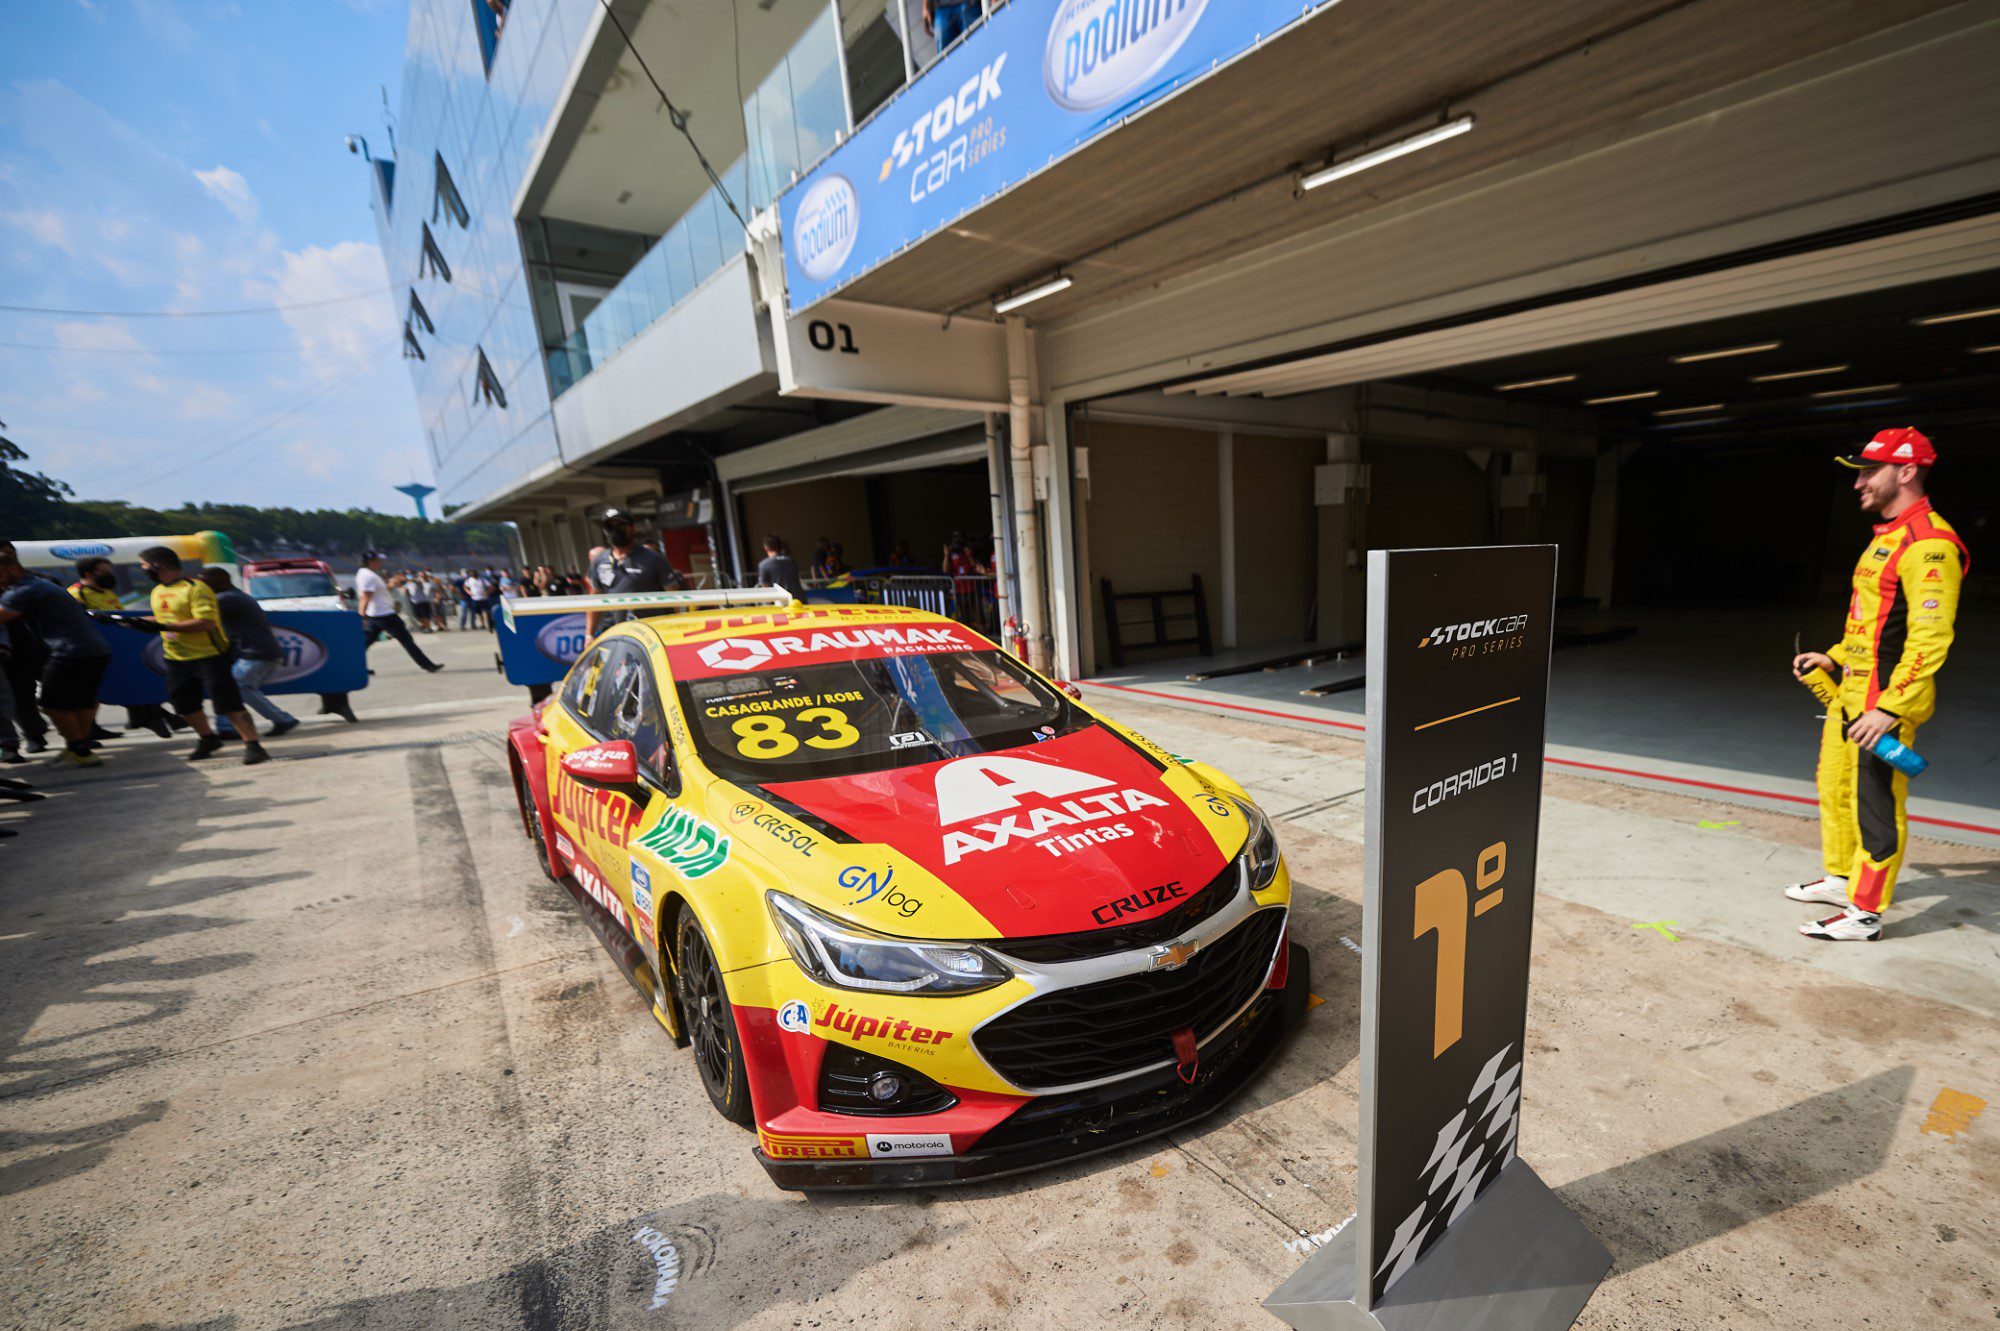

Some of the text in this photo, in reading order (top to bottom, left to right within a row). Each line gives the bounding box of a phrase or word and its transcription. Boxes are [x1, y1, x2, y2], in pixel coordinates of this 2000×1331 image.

[891, 51, 1008, 169] STOCK
[967, 126, 1006, 168] SERIES
[801, 203, 849, 268] podium
[807, 319, 860, 354] 01
[768, 627, 965, 656] RAUMAK
[883, 644, 973, 655] PACKAGING
[1451, 635, 1524, 661] PRO SERIES
[705, 695, 814, 718] CASAGRANDE
[823, 690, 864, 705] ROBE
[731, 706, 860, 760] 83
[1412, 752, 1518, 814] CORRIDA 1
[753, 813, 819, 857] CRESOL
[942, 788, 1170, 866] AXALTA
[1034, 821, 1135, 858] Tintas
[1091, 880, 1189, 925] CRUZE
[814, 1003, 954, 1046] Júpiter
[888, 1041, 936, 1057] BATERIAS
[762, 1132, 857, 1157] PIRELLI
[894, 1140, 945, 1150] motorola
